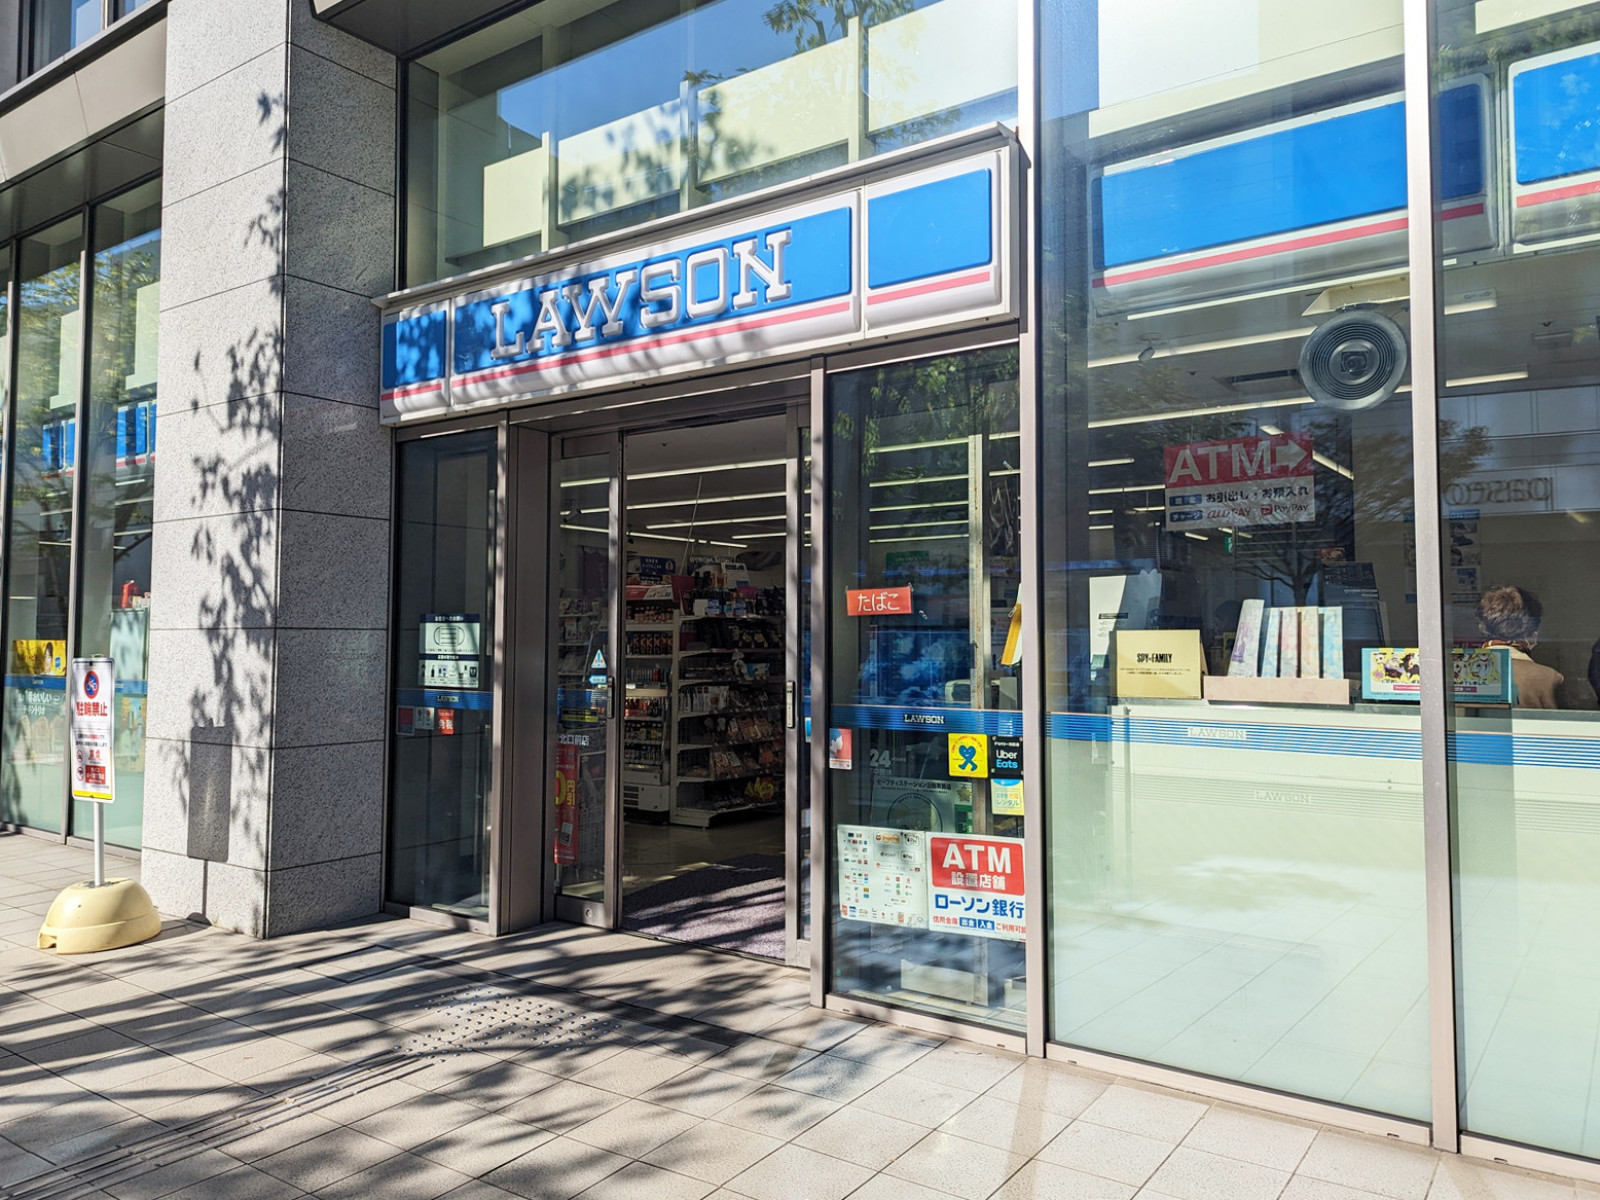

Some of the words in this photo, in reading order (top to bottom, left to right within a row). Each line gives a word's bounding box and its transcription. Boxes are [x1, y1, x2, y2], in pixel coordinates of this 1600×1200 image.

[490, 229, 793, 360] LAWSON
[1168, 440, 1272, 484] ATM
[1207, 510, 1230, 519] au
[1274, 504, 1309, 514] PayPay
[857, 591, 902, 612] たばこ
[76, 702, 108, 717] 駐輪禁止
[439, 719, 454, 730] 免税
[904, 714, 945, 725] LAWSON
[1189, 727, 1245, 740] LAWSON
[870, 749, 892, 768] 24
[996, 749, 1018, 759] Uber
[996, 759, 1019, 769] Eats
[996, 799, 1019, 807] レンタル
[1255, 791, 1310, 803] LAWSON
[942, 843, 1011, 874] ATM
[951, 871, 1006, 890] 設置店舗
[935, 894, 1025, 919] ローソン銀行
[932, 915, 959, 925] 信用金庫
[961, 918, 976, 928] 出金
[980, 920, 994, 930] 入金
